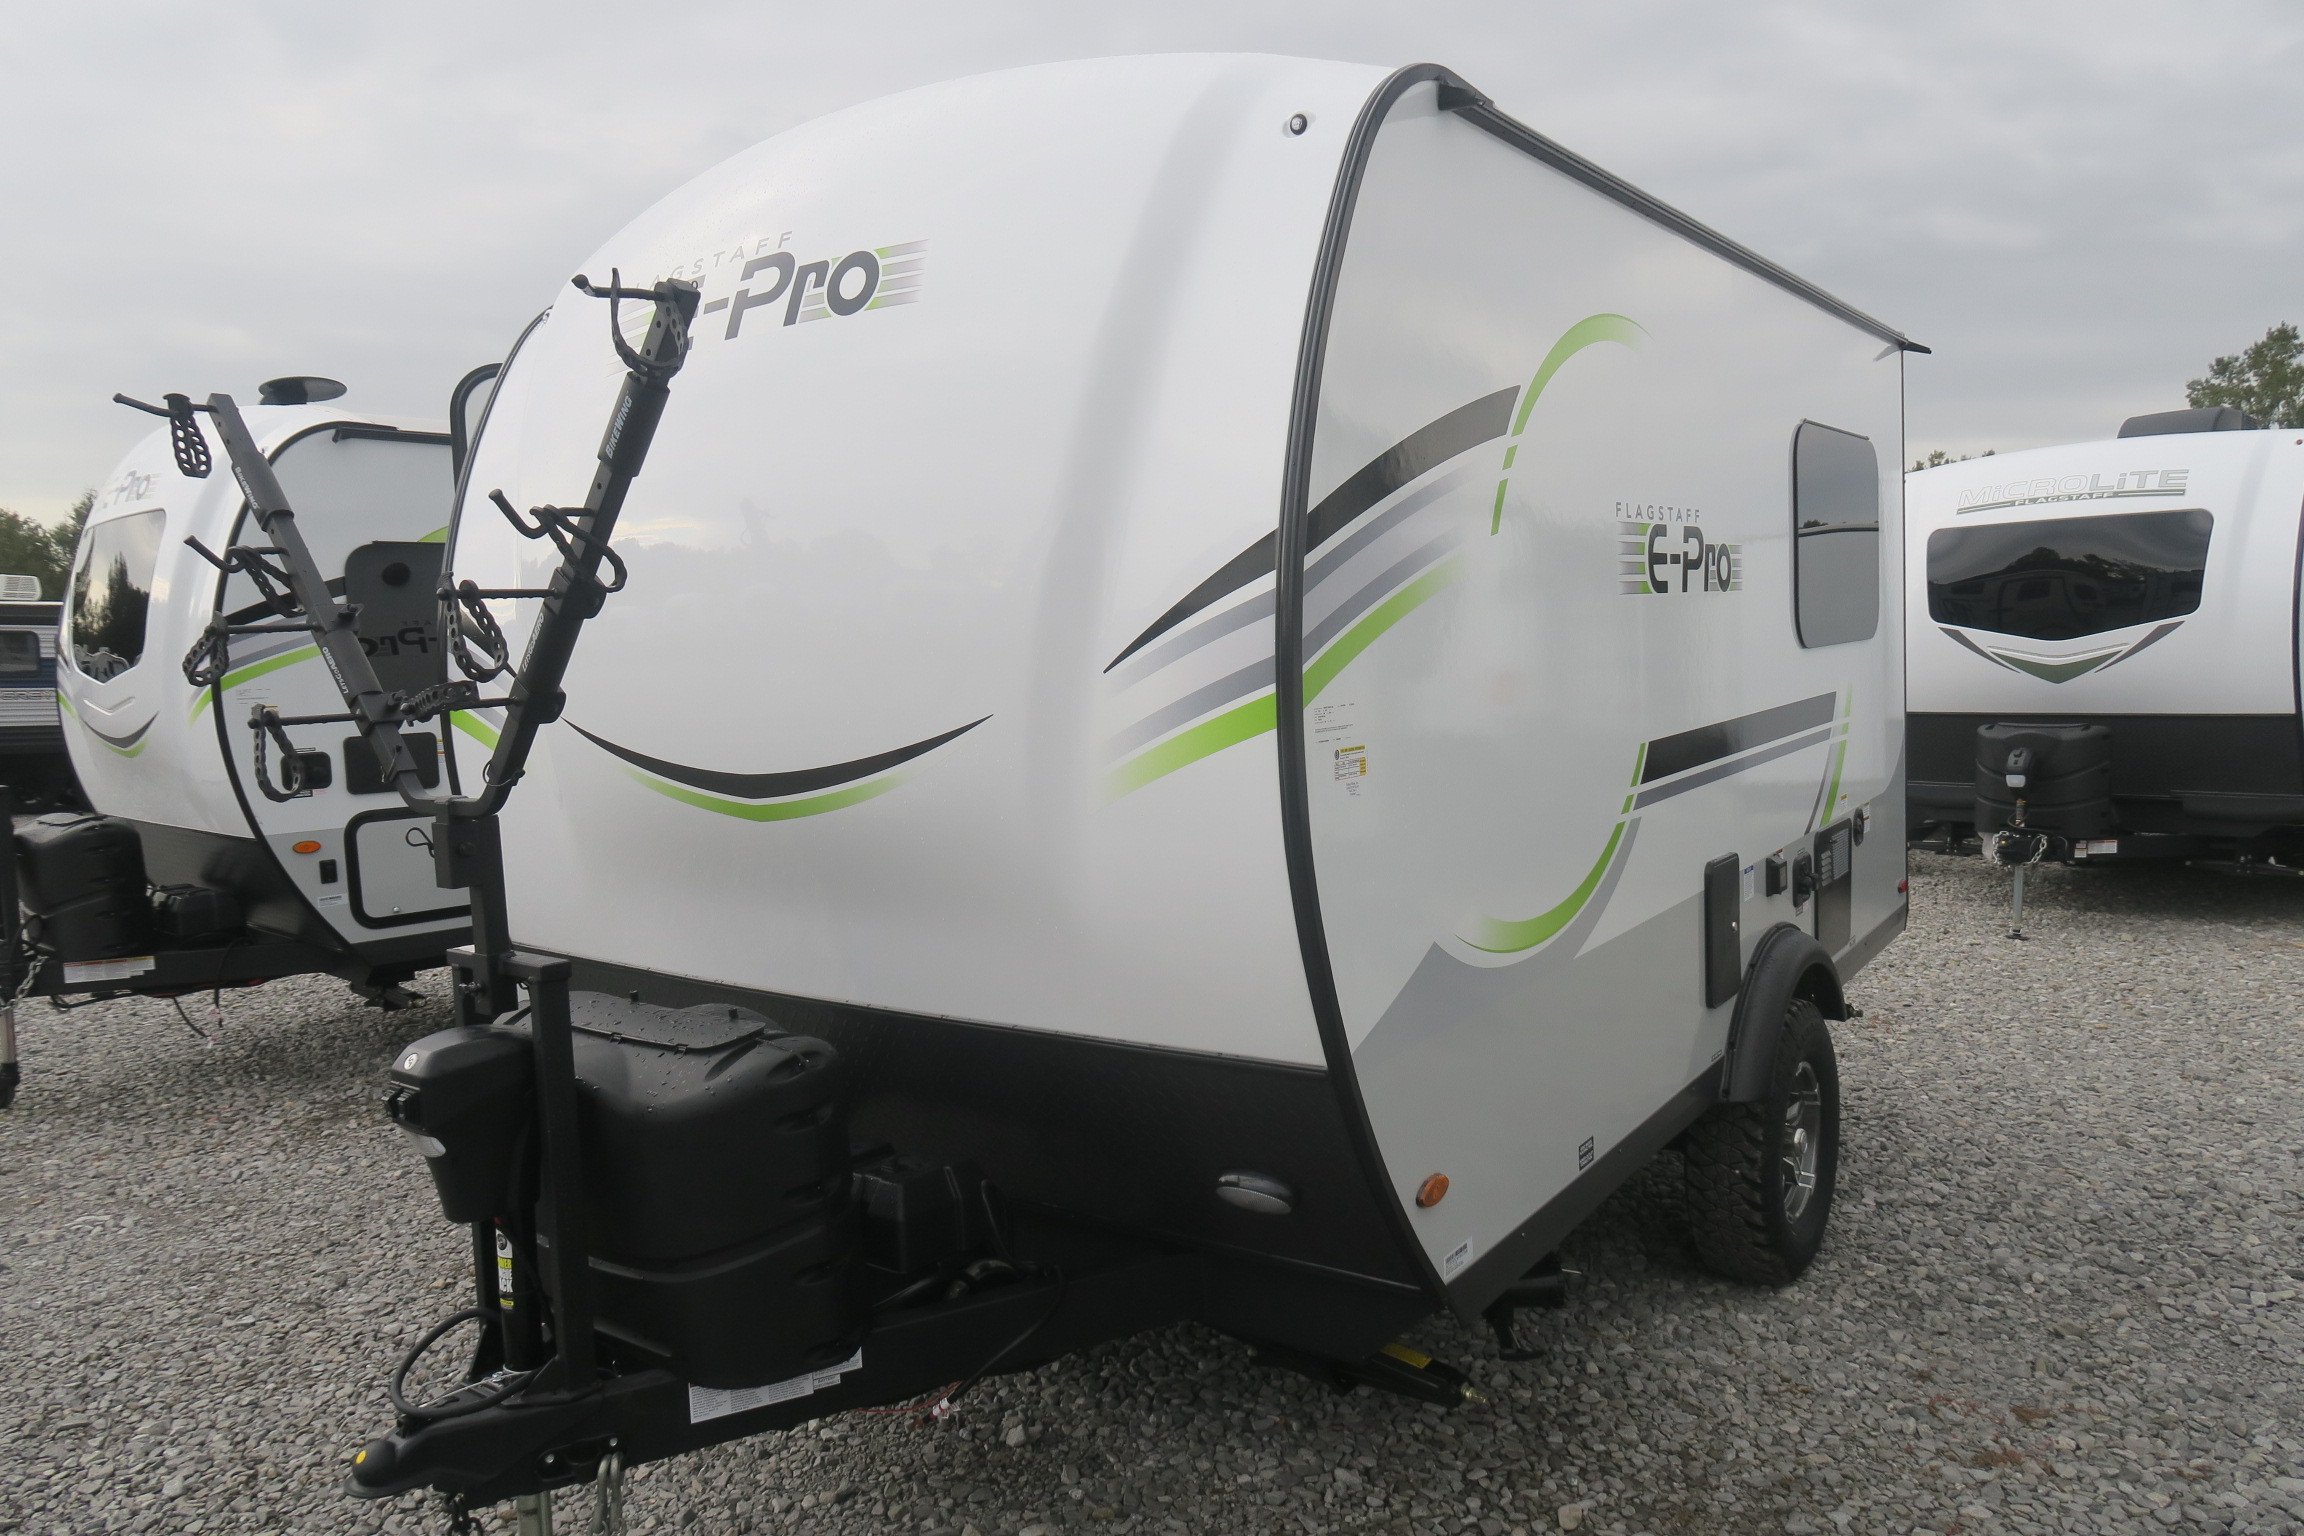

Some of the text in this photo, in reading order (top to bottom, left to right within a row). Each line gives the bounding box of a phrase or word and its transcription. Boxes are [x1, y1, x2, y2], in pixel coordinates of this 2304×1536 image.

[605, 395, 633, 459] BIKEWING
[235, 466, 259, 510] BIKEWING
[2013, 492, 2115, 506] FLAGSTAFF
[1615, 501, 1701, 523] FLAGSTAFF
[1647, 523, 1732, 594] E-Pro
